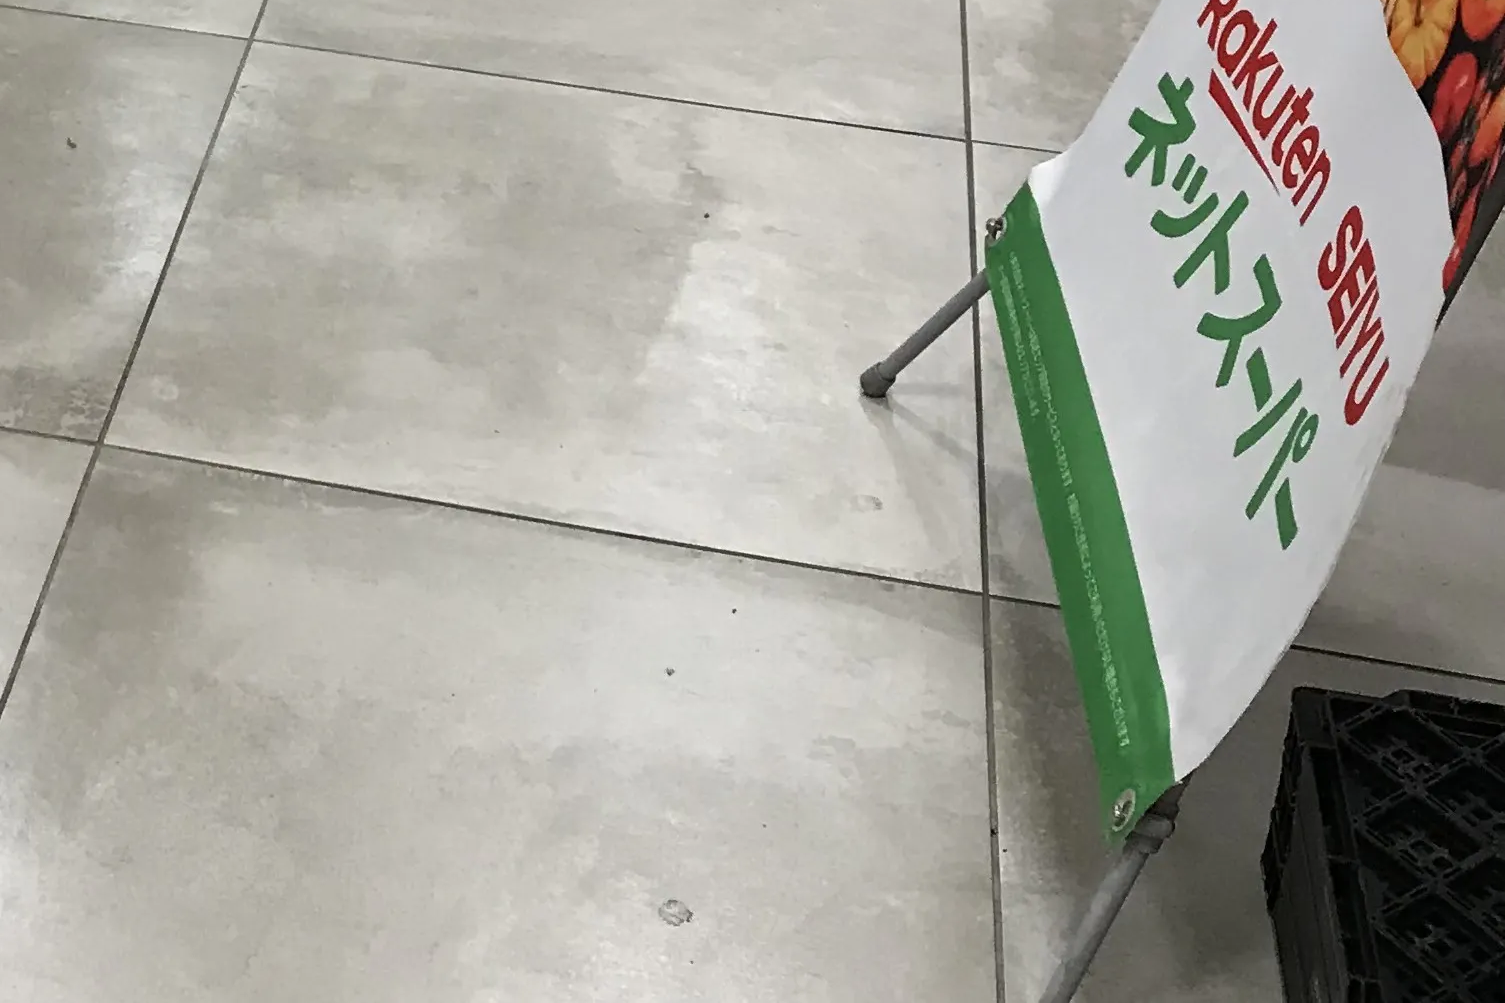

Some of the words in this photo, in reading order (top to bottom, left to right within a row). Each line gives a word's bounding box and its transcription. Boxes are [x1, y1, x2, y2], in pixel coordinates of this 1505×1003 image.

[1124, 71, 1320, 551] ネットスーパー
[1318, 204, 1391, 427] SEIYU
